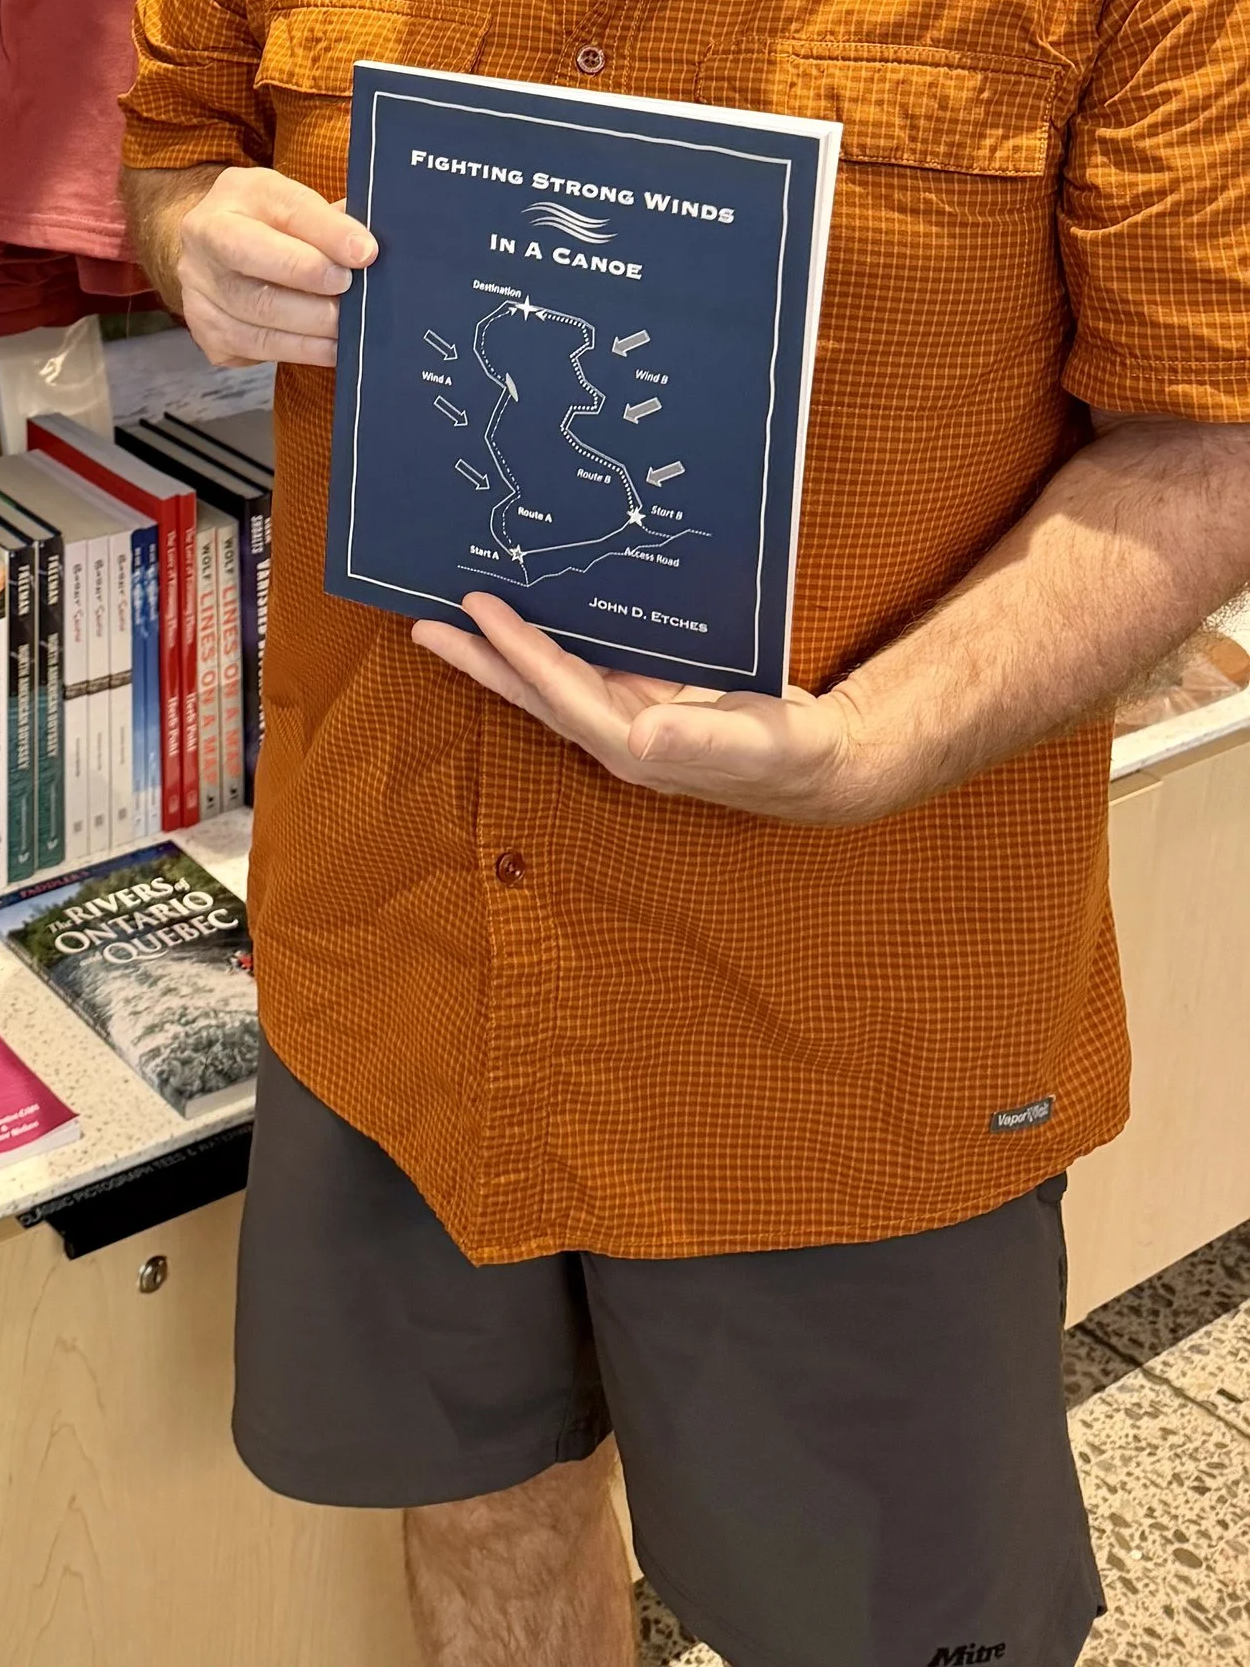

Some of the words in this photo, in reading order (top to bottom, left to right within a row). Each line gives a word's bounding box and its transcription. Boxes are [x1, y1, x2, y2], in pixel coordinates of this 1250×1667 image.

[411, 149, 524, 185] FIGHTING
[531, 171, 635, 206] STRONG
[644, 191, 736, 224] WINDS
[524, 241, 543, 260] A
[552, 247, 643, 280] CANOE
[472, 279, 522, 298] Destination
[422, 370, 444, 384] Wind
[444, 375, 453, 386] A
[635, 369, 659, 384] Wind
[660, 374, 669, 385] B
[577, 467, 603, 483] Route
[603, 474, 612, 485] B
[517, 506, 543, 521] Route
[544, 511, 553, 523] A
[651, 505, 674, 520] Start
[674, 510, 684, 521] B
[223, 535, 235, 575] WOLF
[470, 545, 490, 558] Start
[490, 549, 500, 561] A
[624, 546, 658, 564] Access
[658, 553, 681, 569] Road
[222, 585, 238, 657] LINES
[588, 596, 629, 618] JOHN
[631, 606, 648, 620] D.
[651, 609, 709, 634] ETCHES
[224, 663, 240, 699] ON
[225, 707, 240, 722] A
[226, 727, 241, 779] MAP
[47, 917, 74, 935] The
[64, 876, 174, 926] RIVERS
[173, 875, 192, 894] of
[54, 890, 215, 955] ONTARIO
[102, 908, 240, 965] QUEBEC
